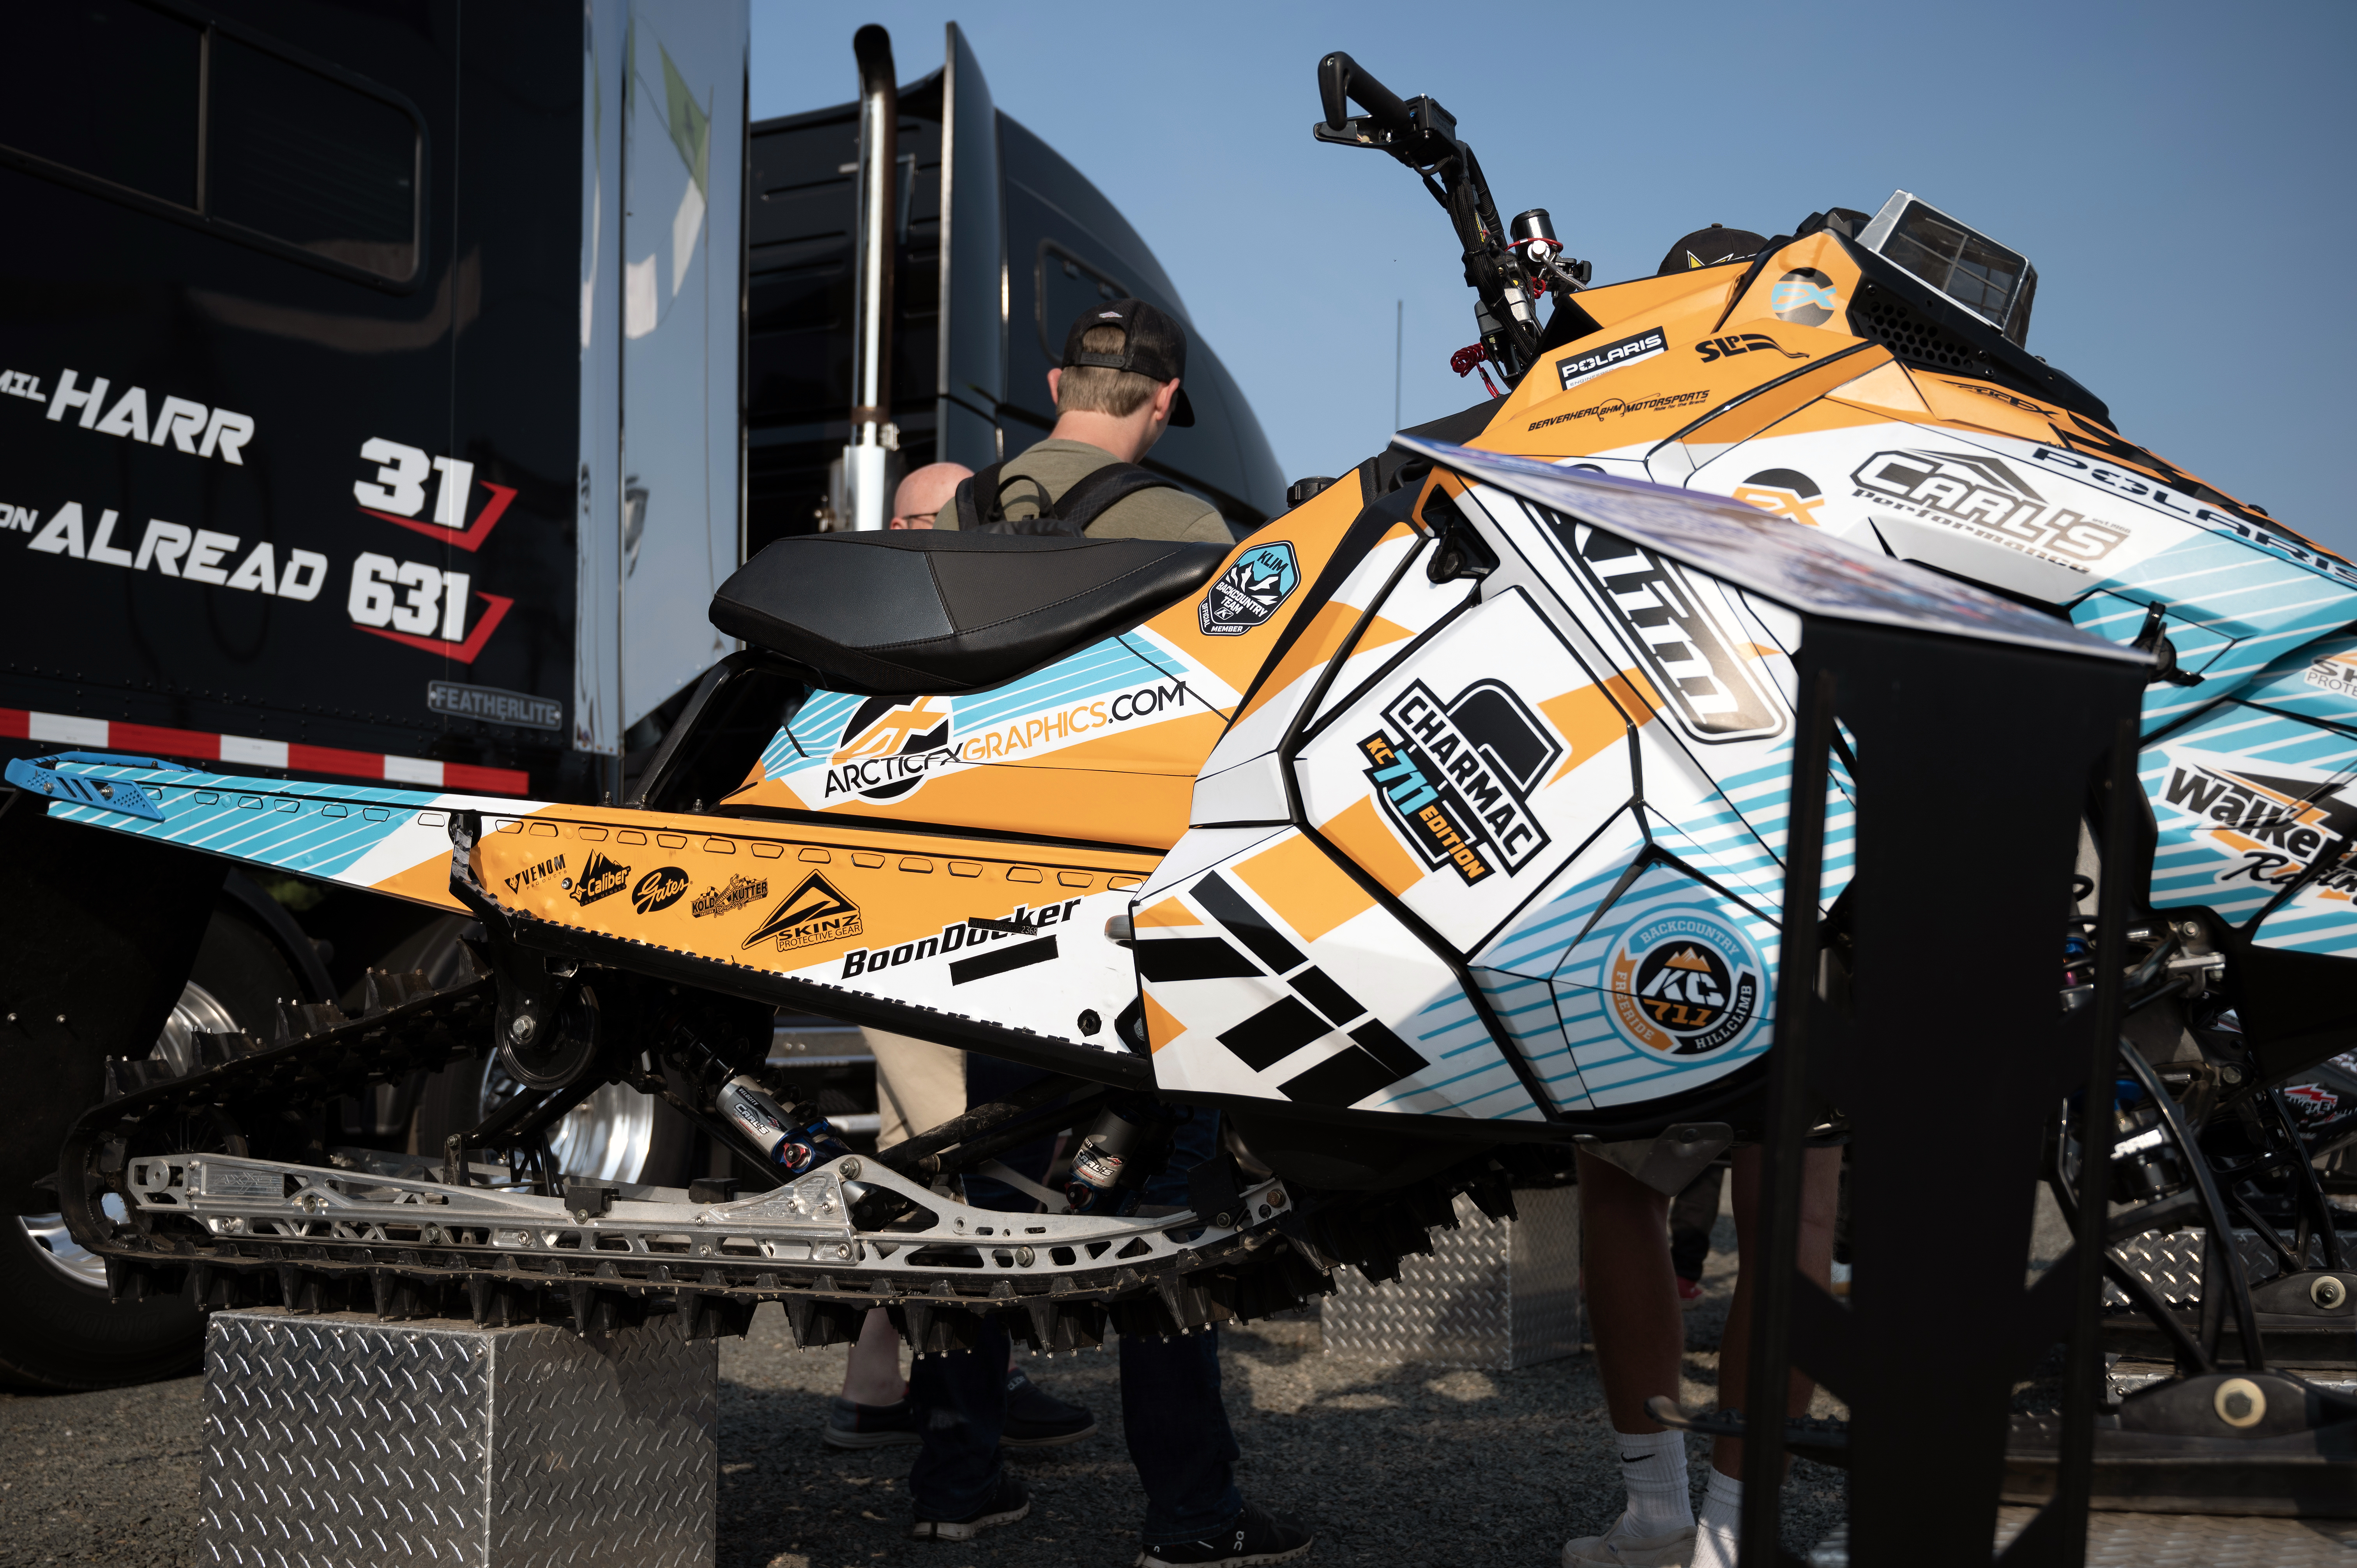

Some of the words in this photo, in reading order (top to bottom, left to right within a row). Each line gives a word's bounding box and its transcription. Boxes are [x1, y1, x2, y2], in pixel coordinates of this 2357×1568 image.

[1562, 334, 1662, 378] POLARIS
[46, 368, 255, 466] HARR
[1528, 406, 1599, 431] BEAVERHEAD
[1600, 404, 1623, 415] BHM
[1626, 390, 1710, 413] MOTORSPORTS
[353, 436, 474, 529] 31
[2032, 447, 2357, 584] POLARIS
[27, 501, 328, 602] ALREAD
[1257, 550, 1289, 571] KLIM
[347, 551, 470, 643] 631
[1201, 602, 1210, 628] OFFICIAL
[1216, 581, 1268, 617] BACKCOUNTRY
[1221, 596, 1244, 614] TEAM
[435, 686, 557, 725] FEATHERLITE
[824, 681, 1187, 798] ARCTICFXGRAPHICS.COM
[1366, 737, 1395, 765] KC
[1373, 749, 1439, 816] 711
[1398, 696, 1533, 857] CHARMAC
[1418, 805, 1485, 879] EDITION
[521, 853, 566, 885] VENOM
[527, 870, 567, 890] PRODUCTS
[587, 869, 627, 897] Caliber
[581, 897, 597, 906] CREW
[601, 885, 626, 898] MEMBER
[634, 872, 689, 913] Gates
[692, 897, 716, 914] KOLD
[731, 881, 769, 902] KUTTER
[714, 898, 749, 918] Racing
[778, 914, 859, 941] SKINZ
[779, 931, 833, 949] PROTECTIVE
[835, 924, 860, 936] GEAR
[1639, 920, 1740, 956] BACKCOUNTRY
[1640, 968, 1725, 1007] KC
[1615, 971, 1655, 1042] FREERIDE
[1643, 998, 1713, 1027] 711
[1694, 985, 1752, 1050] HILLCLIMB
[739, 1088, 759, 1105] VELOCITY
[735, 1102, 770, 1135] CARL'S
[1077, 1148, 1115, 1176] CARL'S
